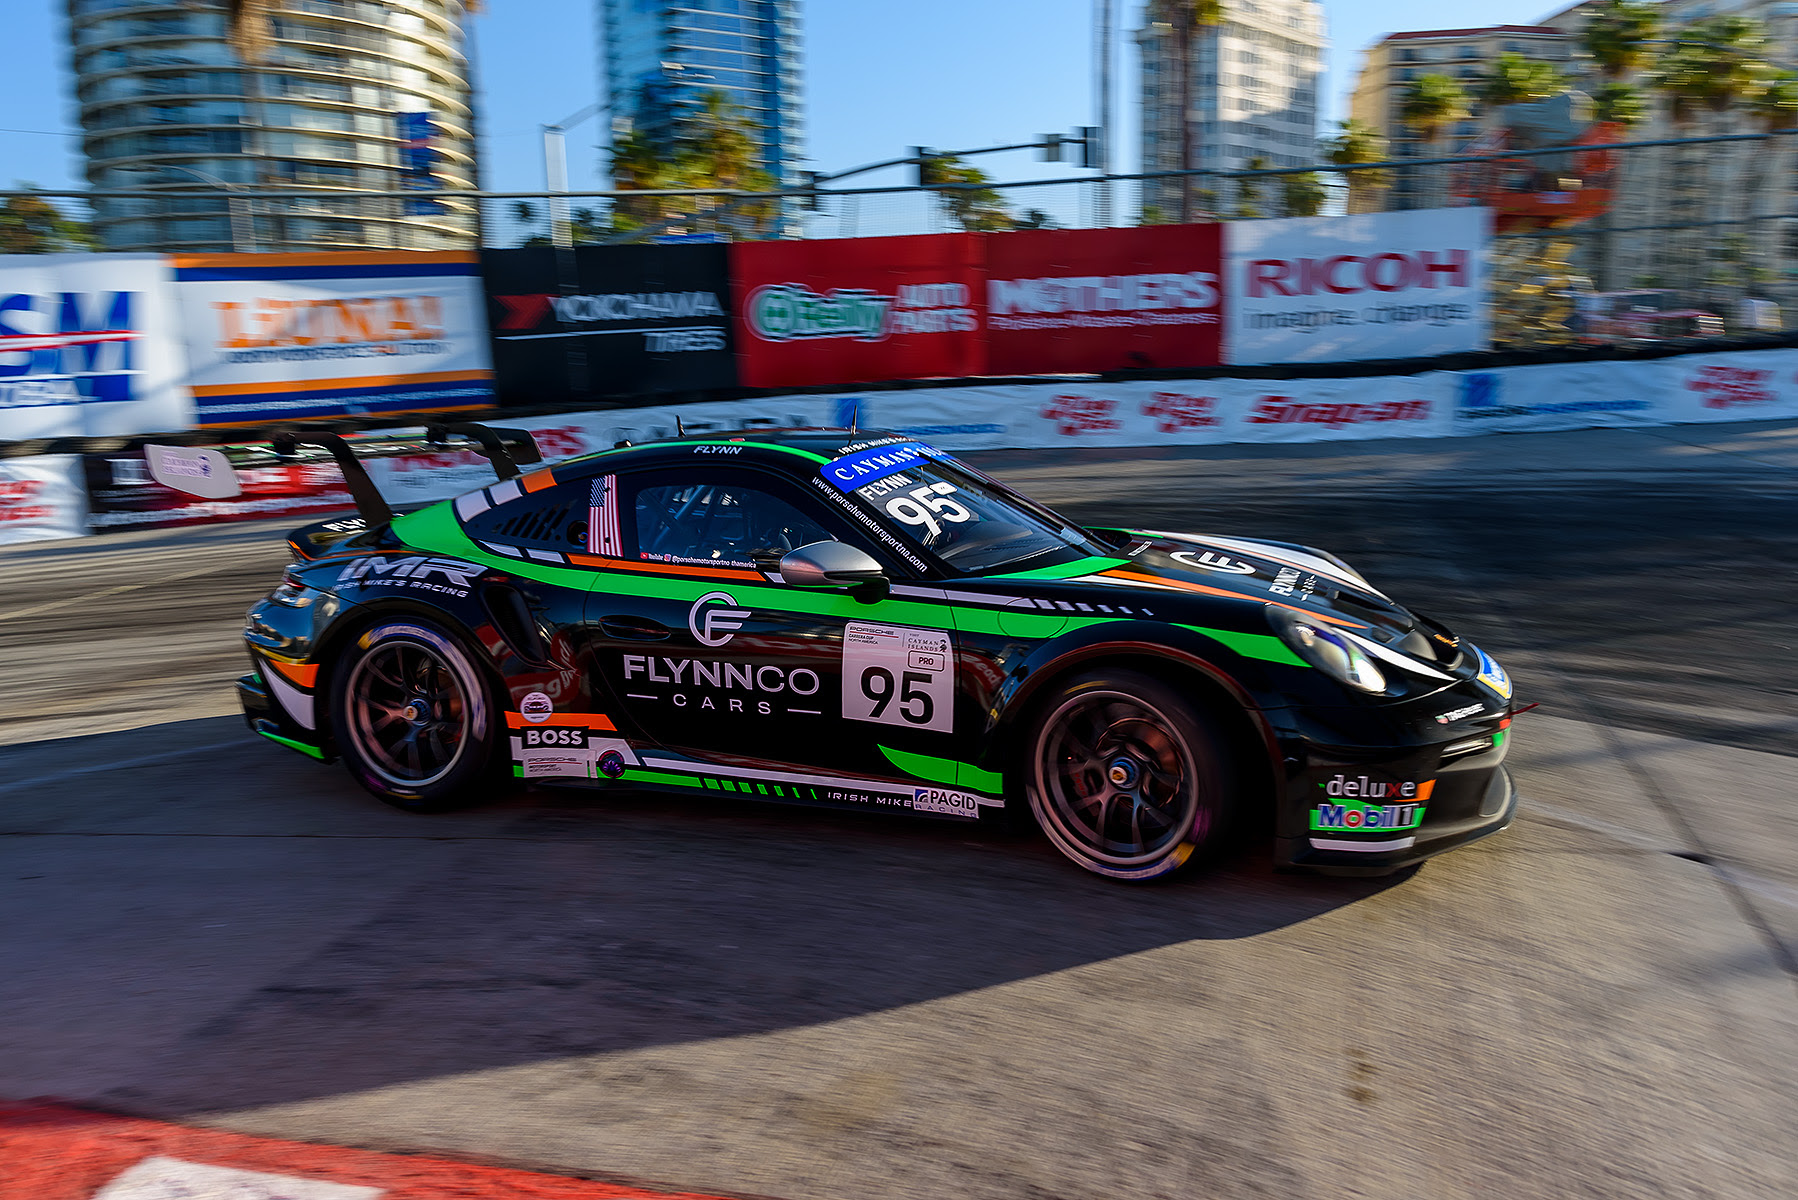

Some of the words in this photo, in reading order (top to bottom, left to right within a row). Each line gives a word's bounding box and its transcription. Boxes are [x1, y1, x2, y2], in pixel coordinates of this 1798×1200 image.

[1245, 250, 1472, 297] RICOH
[897, 282, 971, 308] AUTO
[986, 271, 1222, 314] MOTHERS
[547, 291, 725, 322] YOKOHAMA
[890, 308, 980, 335] PARTS
[642, 330, 727, 352] TIRES
[693, 445, 743, 455] FLYNN
[834, 450, 915, 481] CAYMAN
[858, 473, 913, 501] FLYNN
[885, 481, 971, 538] 95
[321, 517, 368, 531] FLY
[812, 476, 928, 573] www.porschemotorsportna.com
[337, 555, 489, 588] IMR
[363, 578, 408, 587] MIKE'S
[409, 581, 469, 598] RACING
[849, 626, 895, 636] PORSCHE
[907, 637, 939, 647] CAYMAN
[907, 643, 938, 653] ISLANDS
[918, 656, 934, 666] PRO
[623, 654, 820, 695] FLYNNCO
[672, 693, 772, 715] CARS
[860, 665, 934, 725] 95
[526, 730, 583, 745] BOSS
[827, 791, 868, 803] IRISH
[1326, 775, 1416, 798] deluxe
[915, 804, 978, 819] RACING
[930, 791, 977, 811] PAGID
[1317, 804, 1397, 829] Mobil
[1401, 807, 1414, 825] 1
